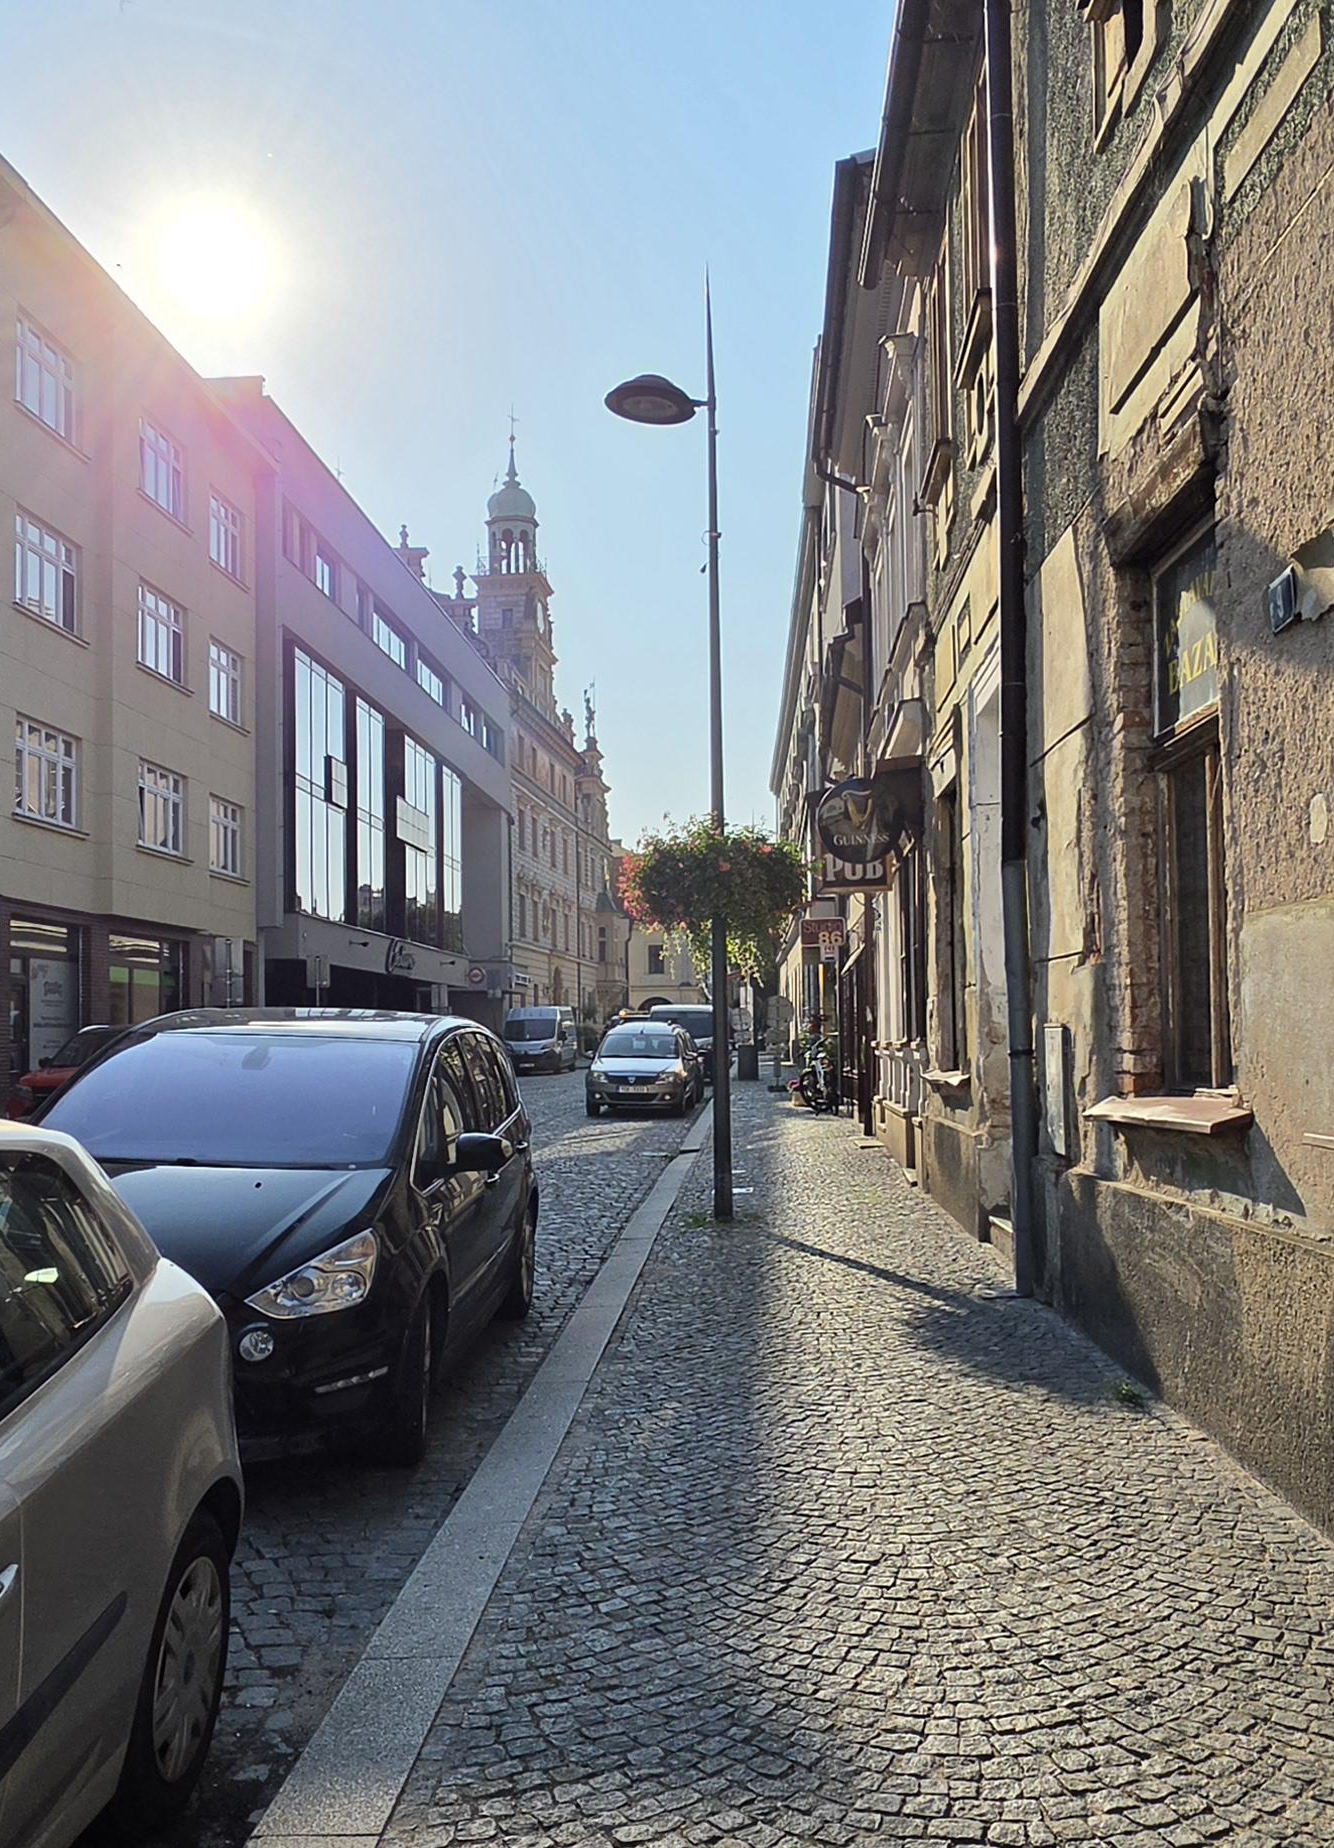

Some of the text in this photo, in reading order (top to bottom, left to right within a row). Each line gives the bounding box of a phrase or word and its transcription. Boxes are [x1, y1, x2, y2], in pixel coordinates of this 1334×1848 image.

[832, 831, 890, 847] GUINNESS
[824, 853, 884, 882] PUB
[818, 931, 843, 946] 86
